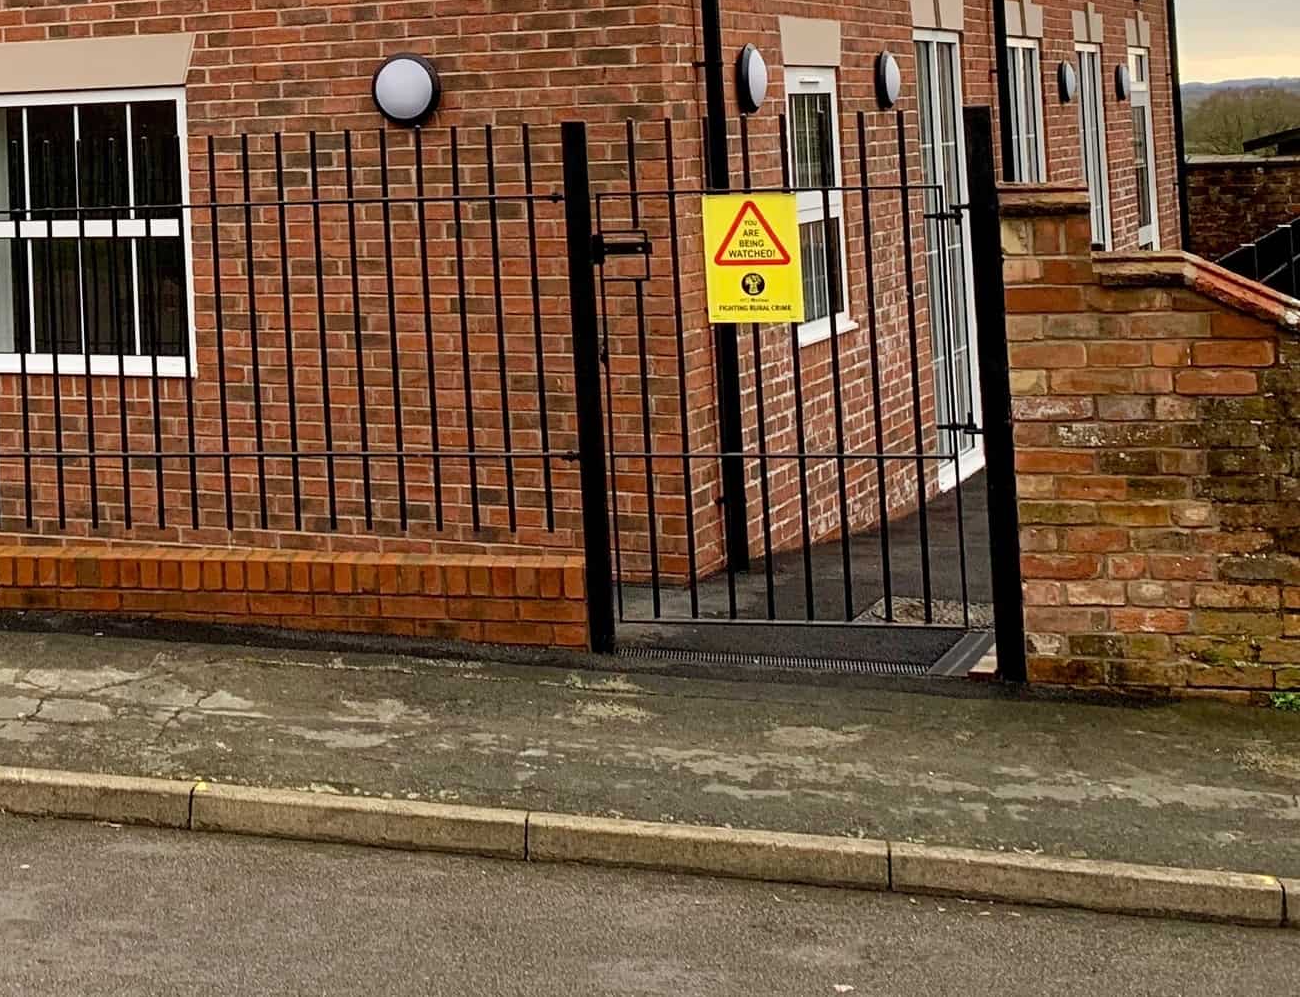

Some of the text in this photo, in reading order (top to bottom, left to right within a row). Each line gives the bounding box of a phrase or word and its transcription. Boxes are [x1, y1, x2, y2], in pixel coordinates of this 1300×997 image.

[743, 229, 760, 237] ARE
[739, 239, 764, 248] BEING
[728, 249, 775, 258] WATCHED!
[718, 304, 792, 312] FIGHTING RURAL CRIME
